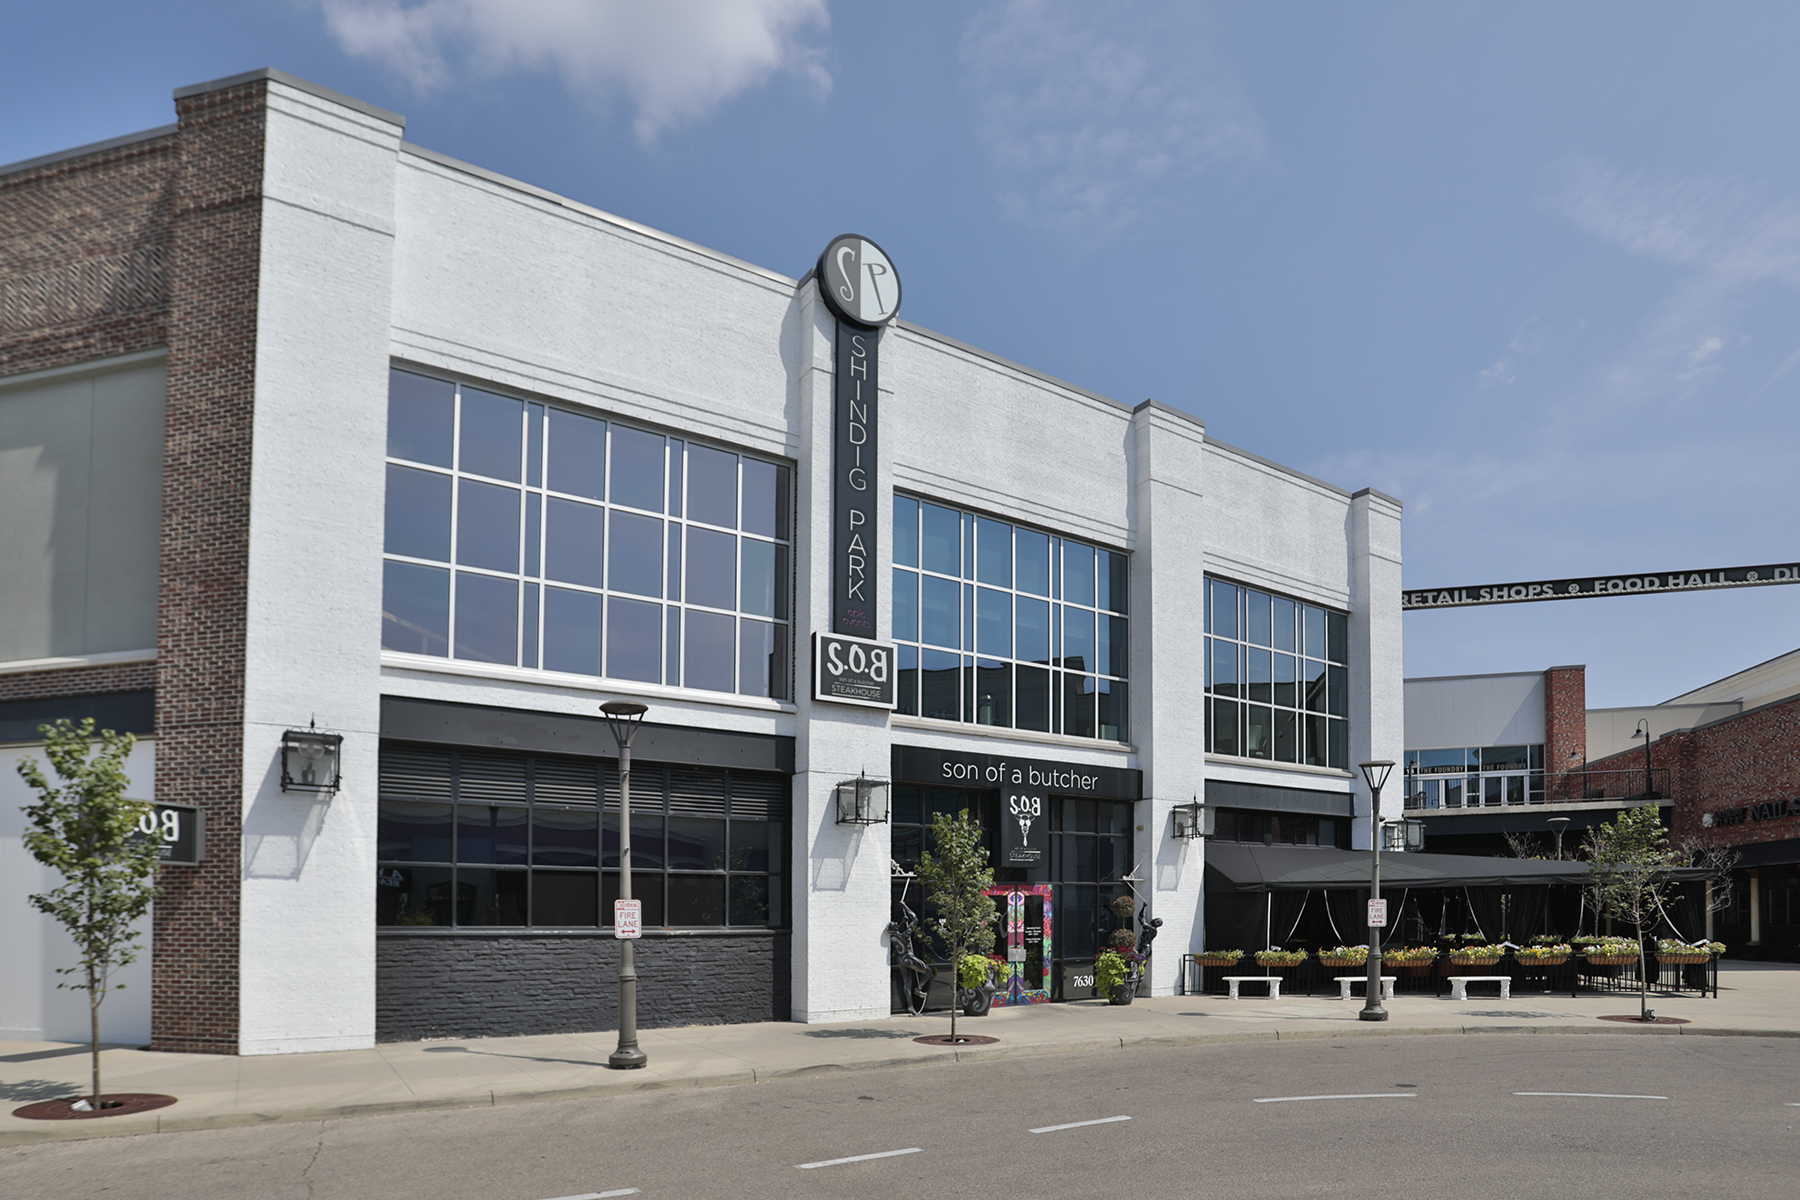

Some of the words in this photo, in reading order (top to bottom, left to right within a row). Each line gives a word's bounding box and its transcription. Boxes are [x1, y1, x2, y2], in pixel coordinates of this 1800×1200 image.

[849, 335, 867, 490] SHINDIG
[848, 510, 866, 601] PARK
[1402, 589, 1473, 607] RETAIL
[1479, 583, 1554, 601] SHOPS
[1594, 576, 1660, 593] FOOD
[1667, 571, 1731, 588] HALL
[842, 617, 871, 629] events
[831, 684, 881, 698] STEAKHOUSE
[1434, 765, 1465, 774] FOUNDRY
[1496, 762, 1527, 771] FOUNDRY
[942, 762, 979, 780] son
[985, 762, 1006, 782] of
[1011, 768, 1022, 784] a
[1029, 765, 1099, 790] butcher
[1750, 801, 1788, 821] NAIL
[619, 911, 637, 919] FIRE
[1073, 974, 1094, 987] 7630
